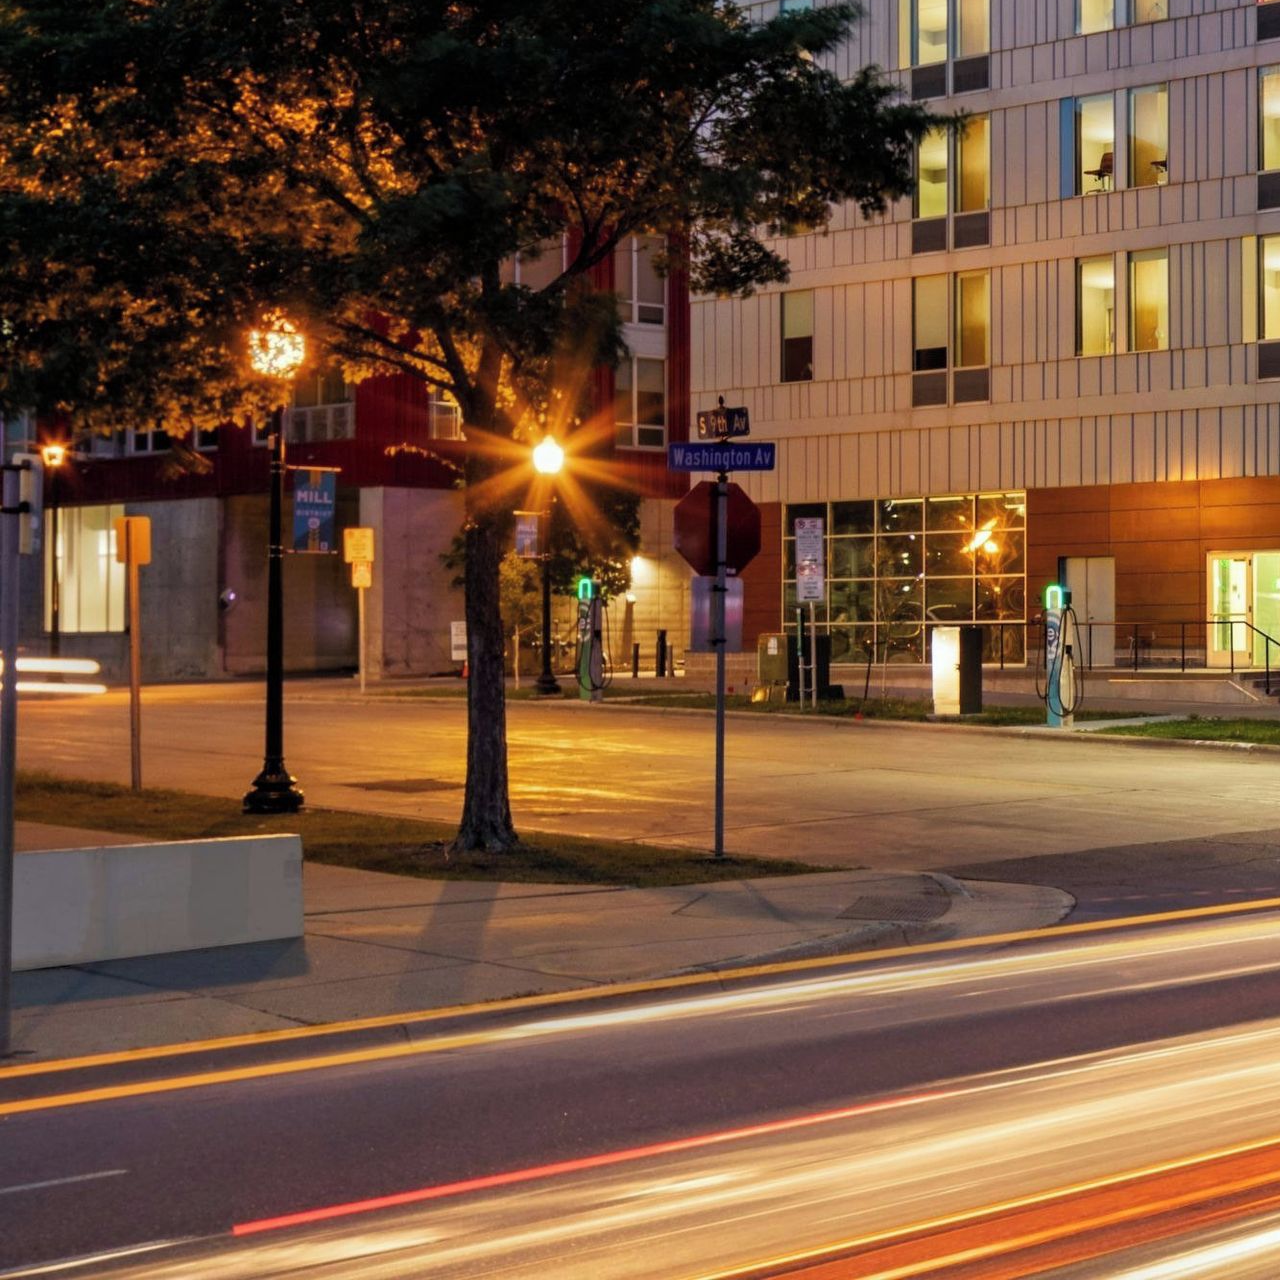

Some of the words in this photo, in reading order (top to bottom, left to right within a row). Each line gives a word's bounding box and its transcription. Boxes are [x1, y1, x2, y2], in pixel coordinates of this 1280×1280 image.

[700, 416, 707, 434] S
[710, 415, 728, 432] 9th
[733, 414, 747, 431] Av
[673, 447, 751, 470] Washington
[755, 447, 772, 465] Av
[296, 490, 333, 504] MILL
